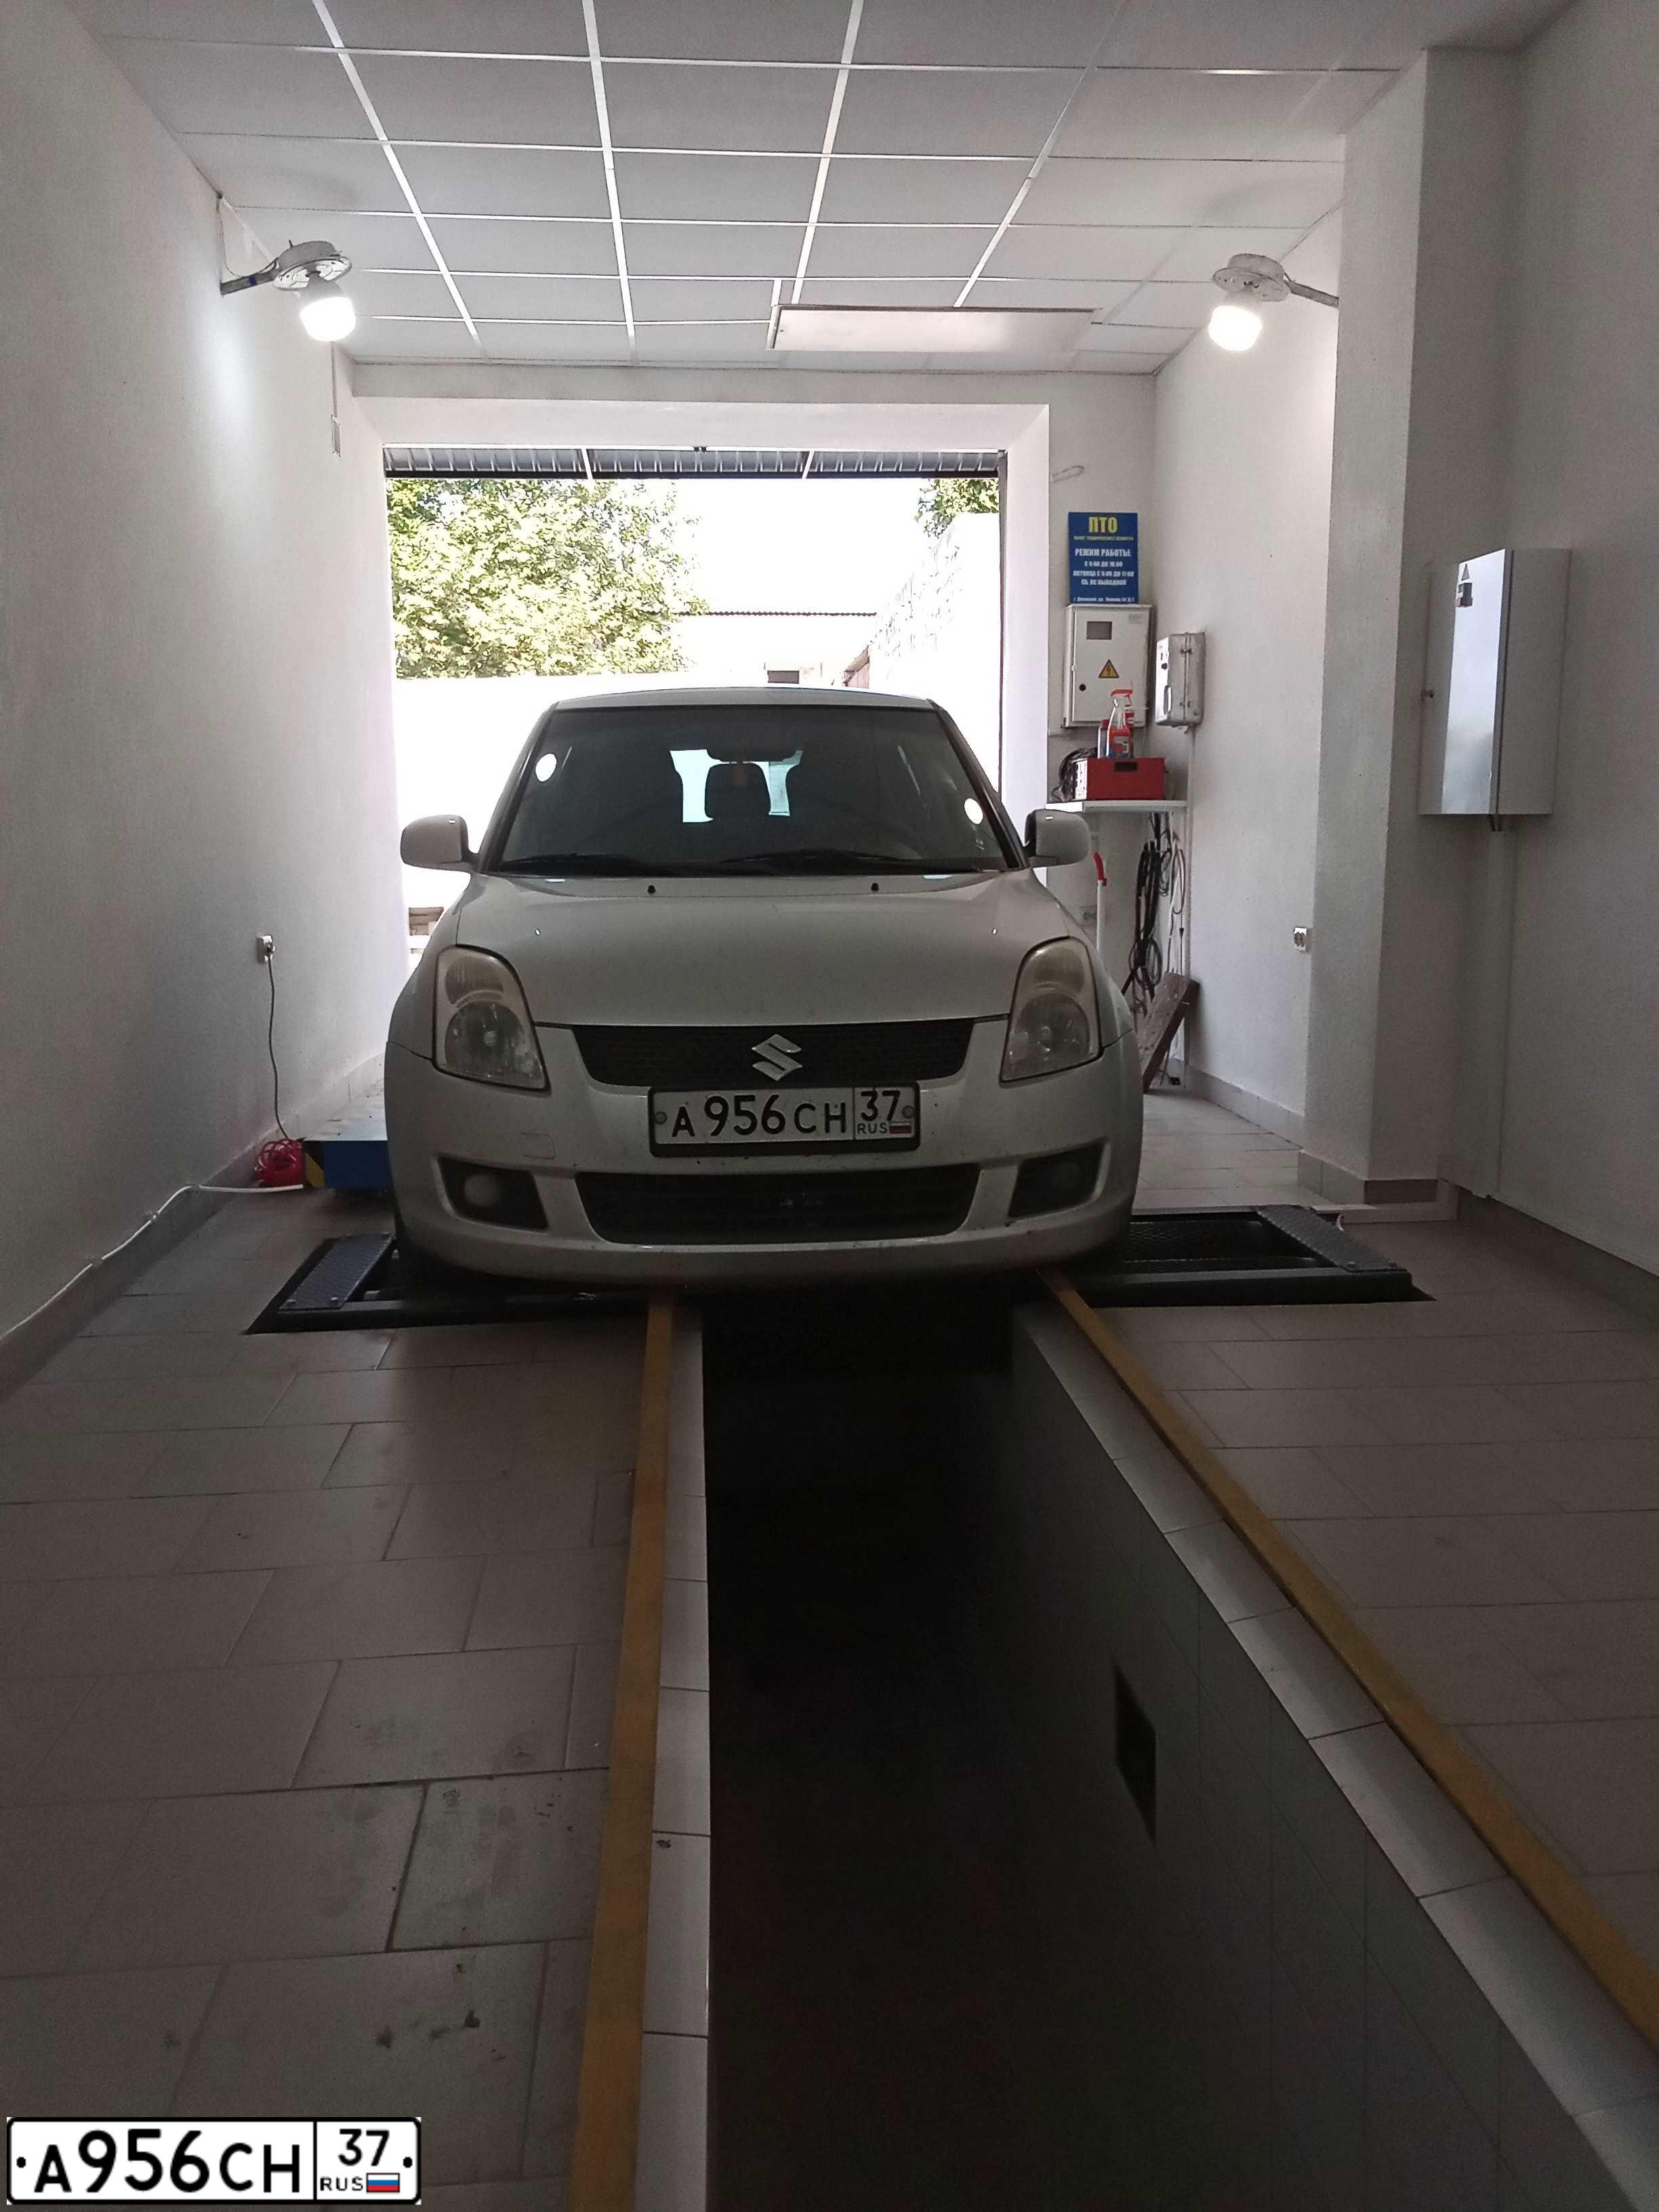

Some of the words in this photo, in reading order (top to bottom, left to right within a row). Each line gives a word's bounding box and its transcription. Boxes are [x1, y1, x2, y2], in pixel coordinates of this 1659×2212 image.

[1088, 516, 1118, 533] ПТО
[1075, 548, 1100, 556] РЕЖИМ
[860, 1090, 901, 1121] 37
[857, 1122, 888, 1134] RUS
